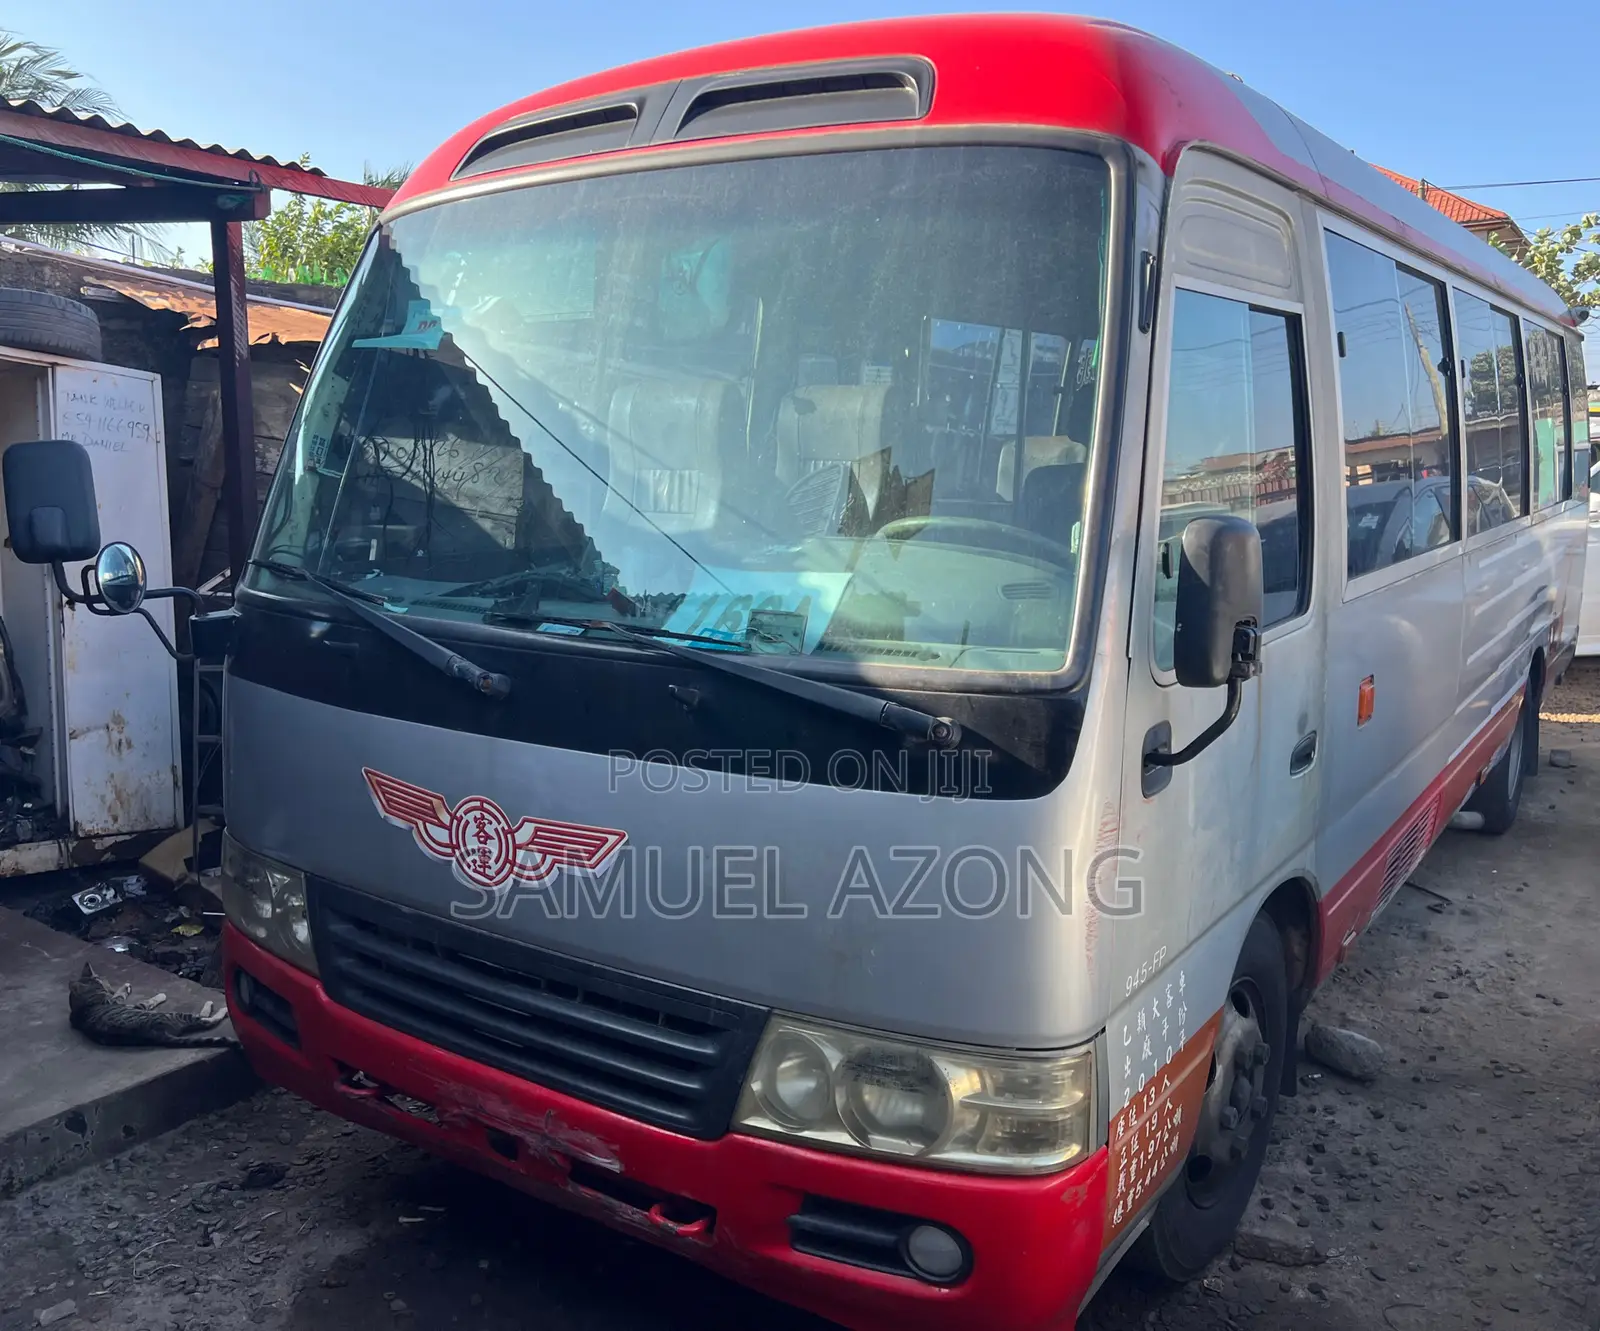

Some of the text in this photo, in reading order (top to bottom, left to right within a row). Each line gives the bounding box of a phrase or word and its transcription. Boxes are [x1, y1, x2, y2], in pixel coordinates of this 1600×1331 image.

[82, 431, 127, 453] DANIEL
[469, 812, 496, 881] 客運
[1125, 946, 1167, 998] 945-FP
